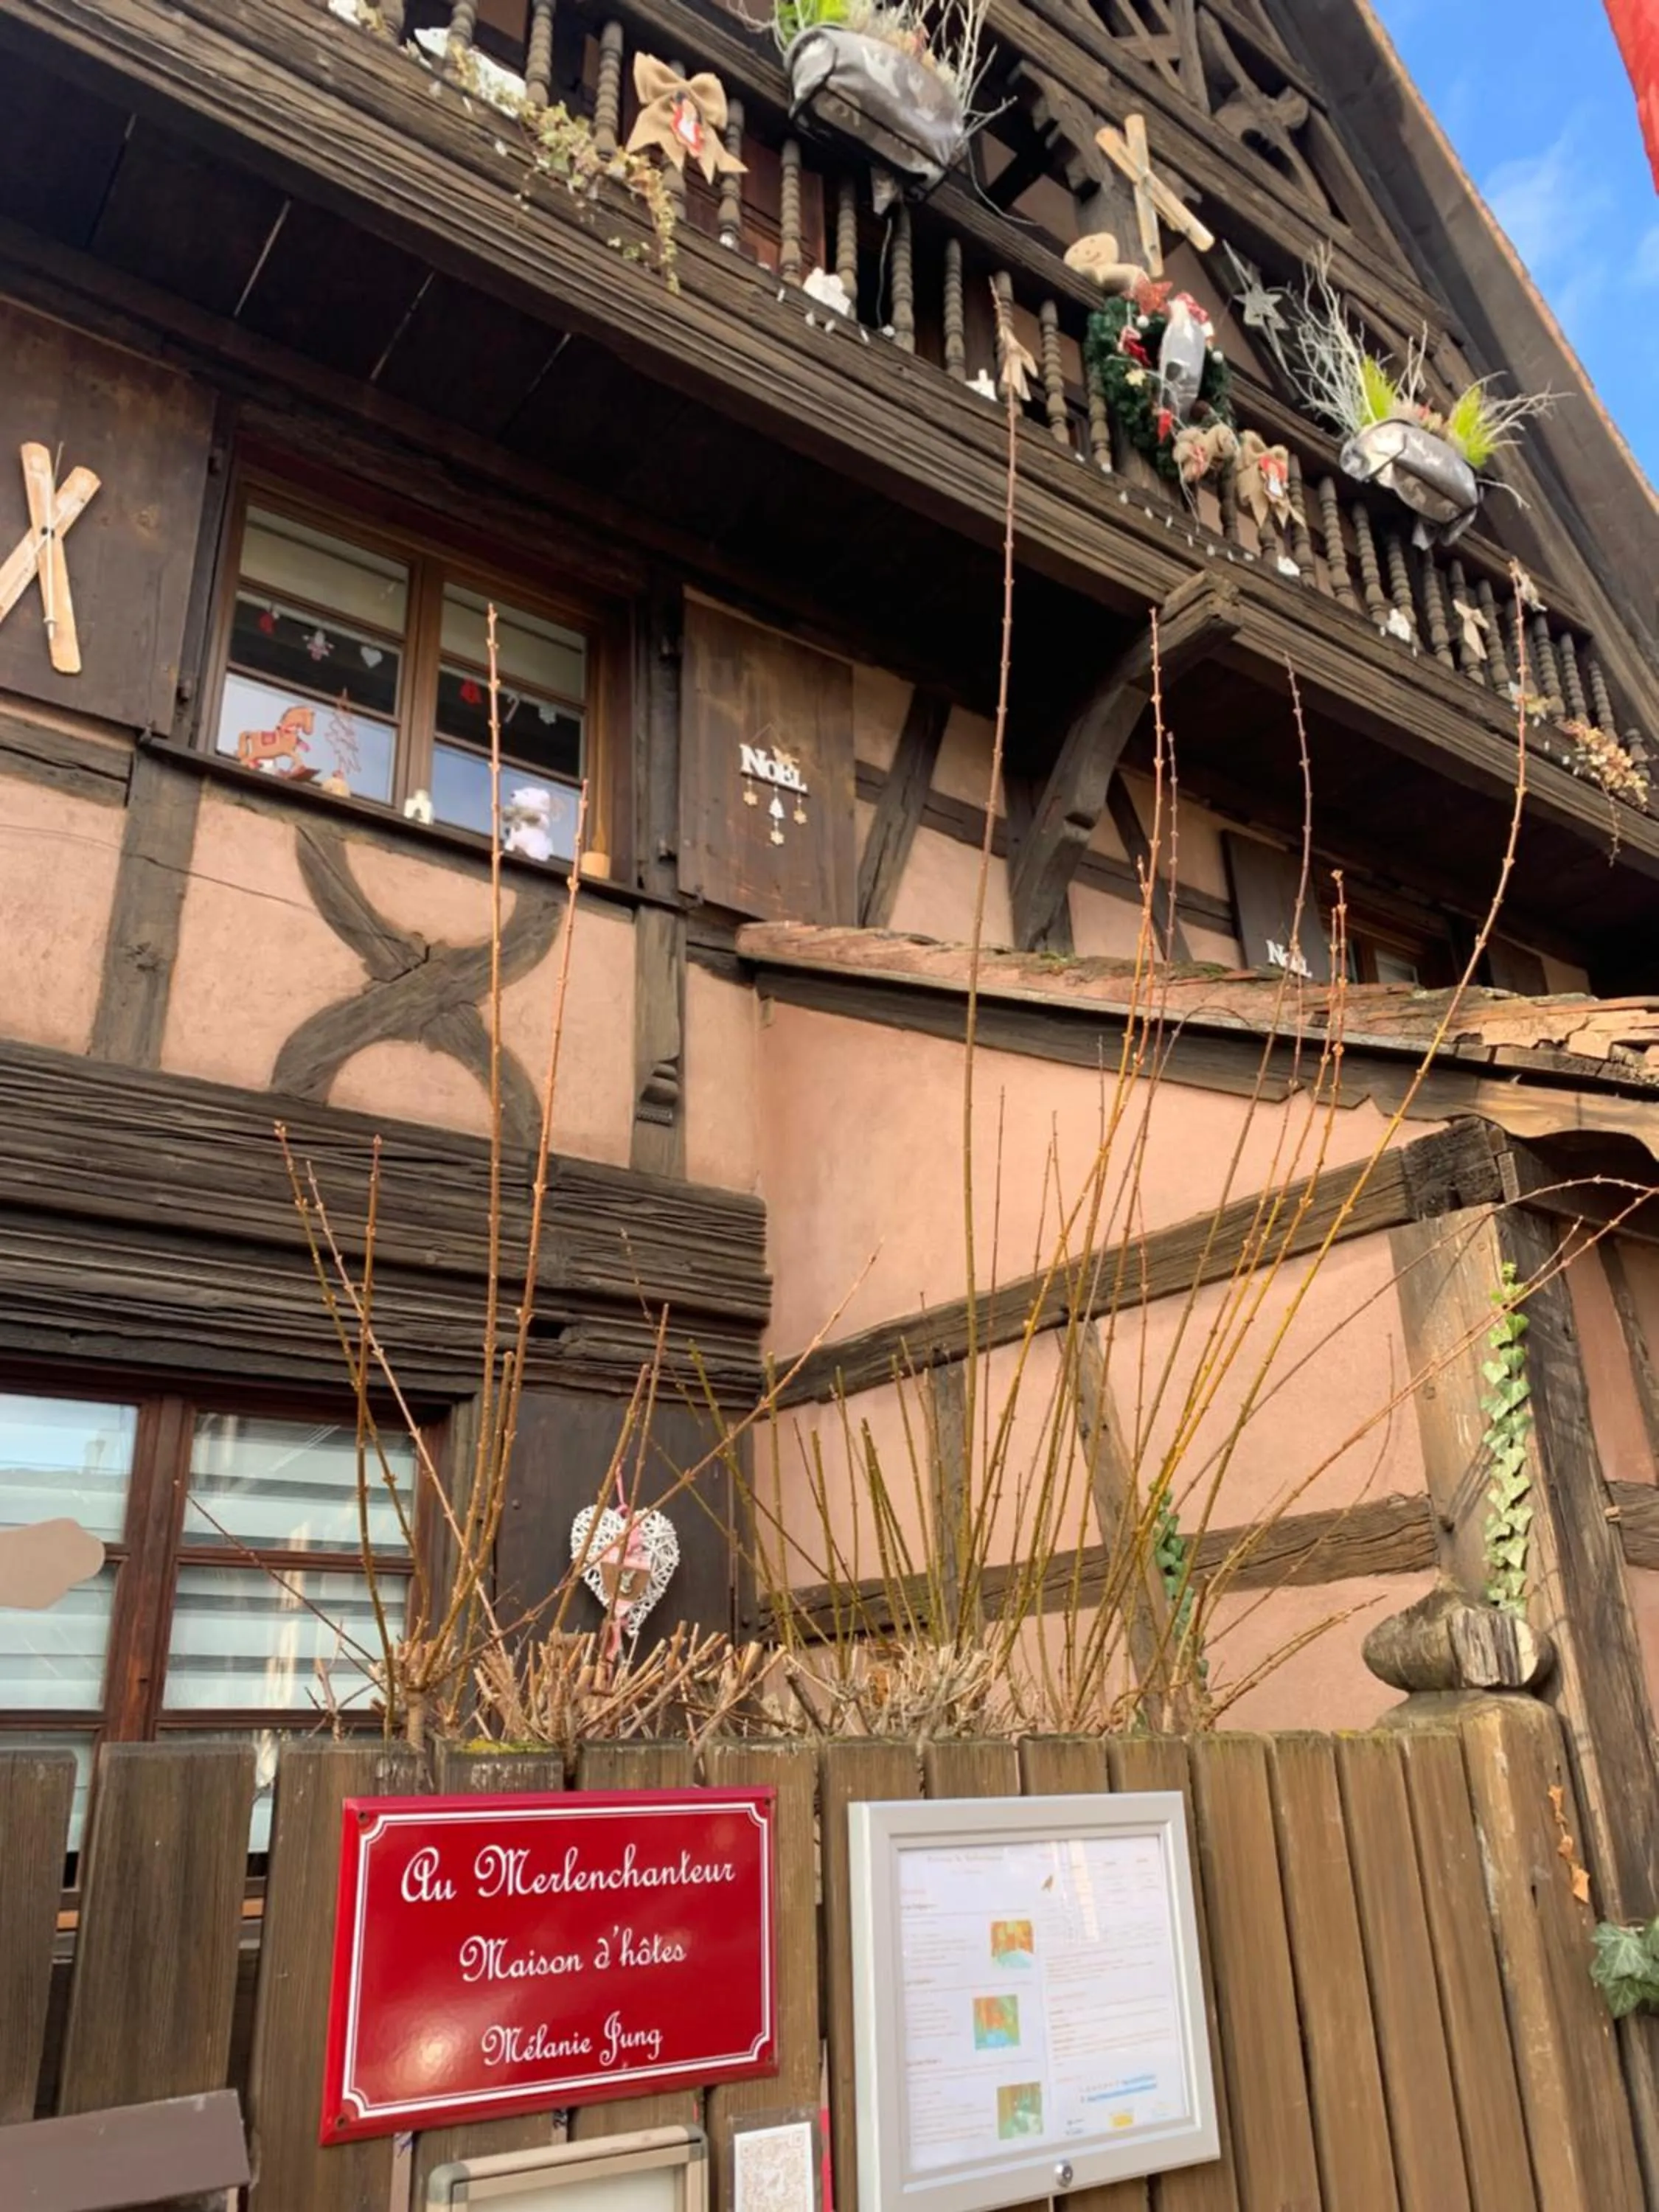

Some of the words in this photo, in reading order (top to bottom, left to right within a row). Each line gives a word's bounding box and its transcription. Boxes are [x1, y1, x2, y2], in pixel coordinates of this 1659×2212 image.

[400, 1846, 457, 1903] Au
[473, 1843, 736, 1899] Merlenchanteur
[459, 1935, 583, 1983] Maison
[594, 1924, 686, 1971] d'hôtes
[481, 2023, 592, 2067] Mélanie
[599, 2010, 664, 2067] Jung
